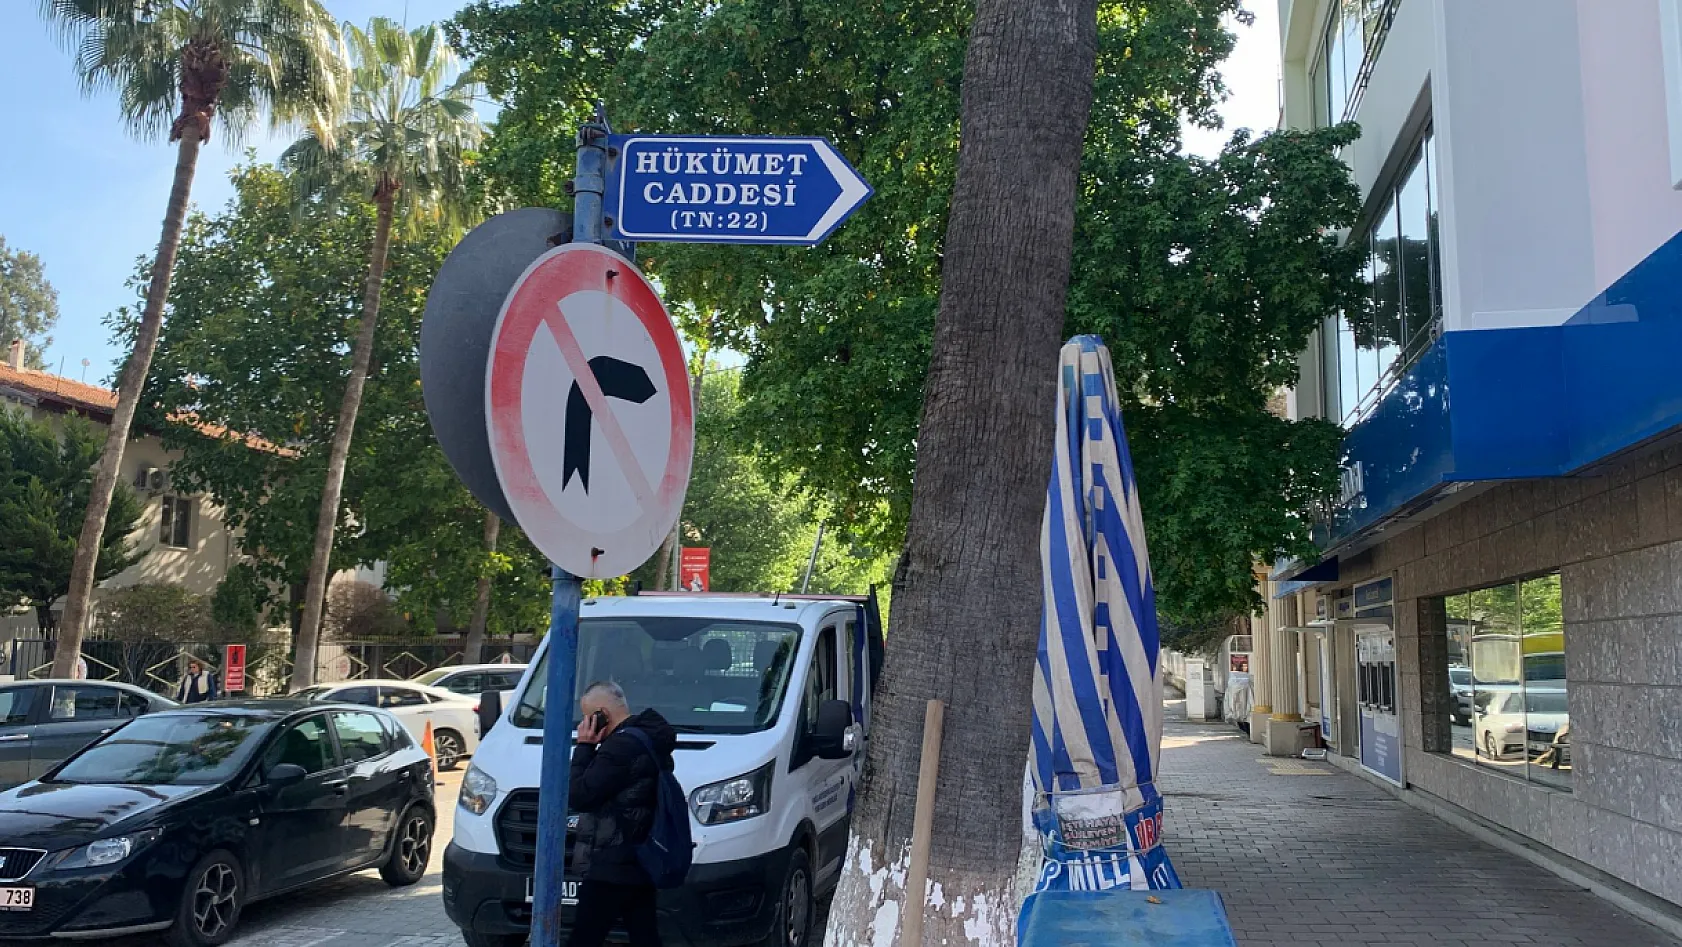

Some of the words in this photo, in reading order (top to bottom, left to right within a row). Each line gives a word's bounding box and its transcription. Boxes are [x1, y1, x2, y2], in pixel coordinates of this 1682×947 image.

[635, 147, 808, 175] HÜKÜMET
[643, 179, 797, 206] CADDESİ
[670, 210, 768, 231] (TN:22)
[6, 889, 31, 905] 738
